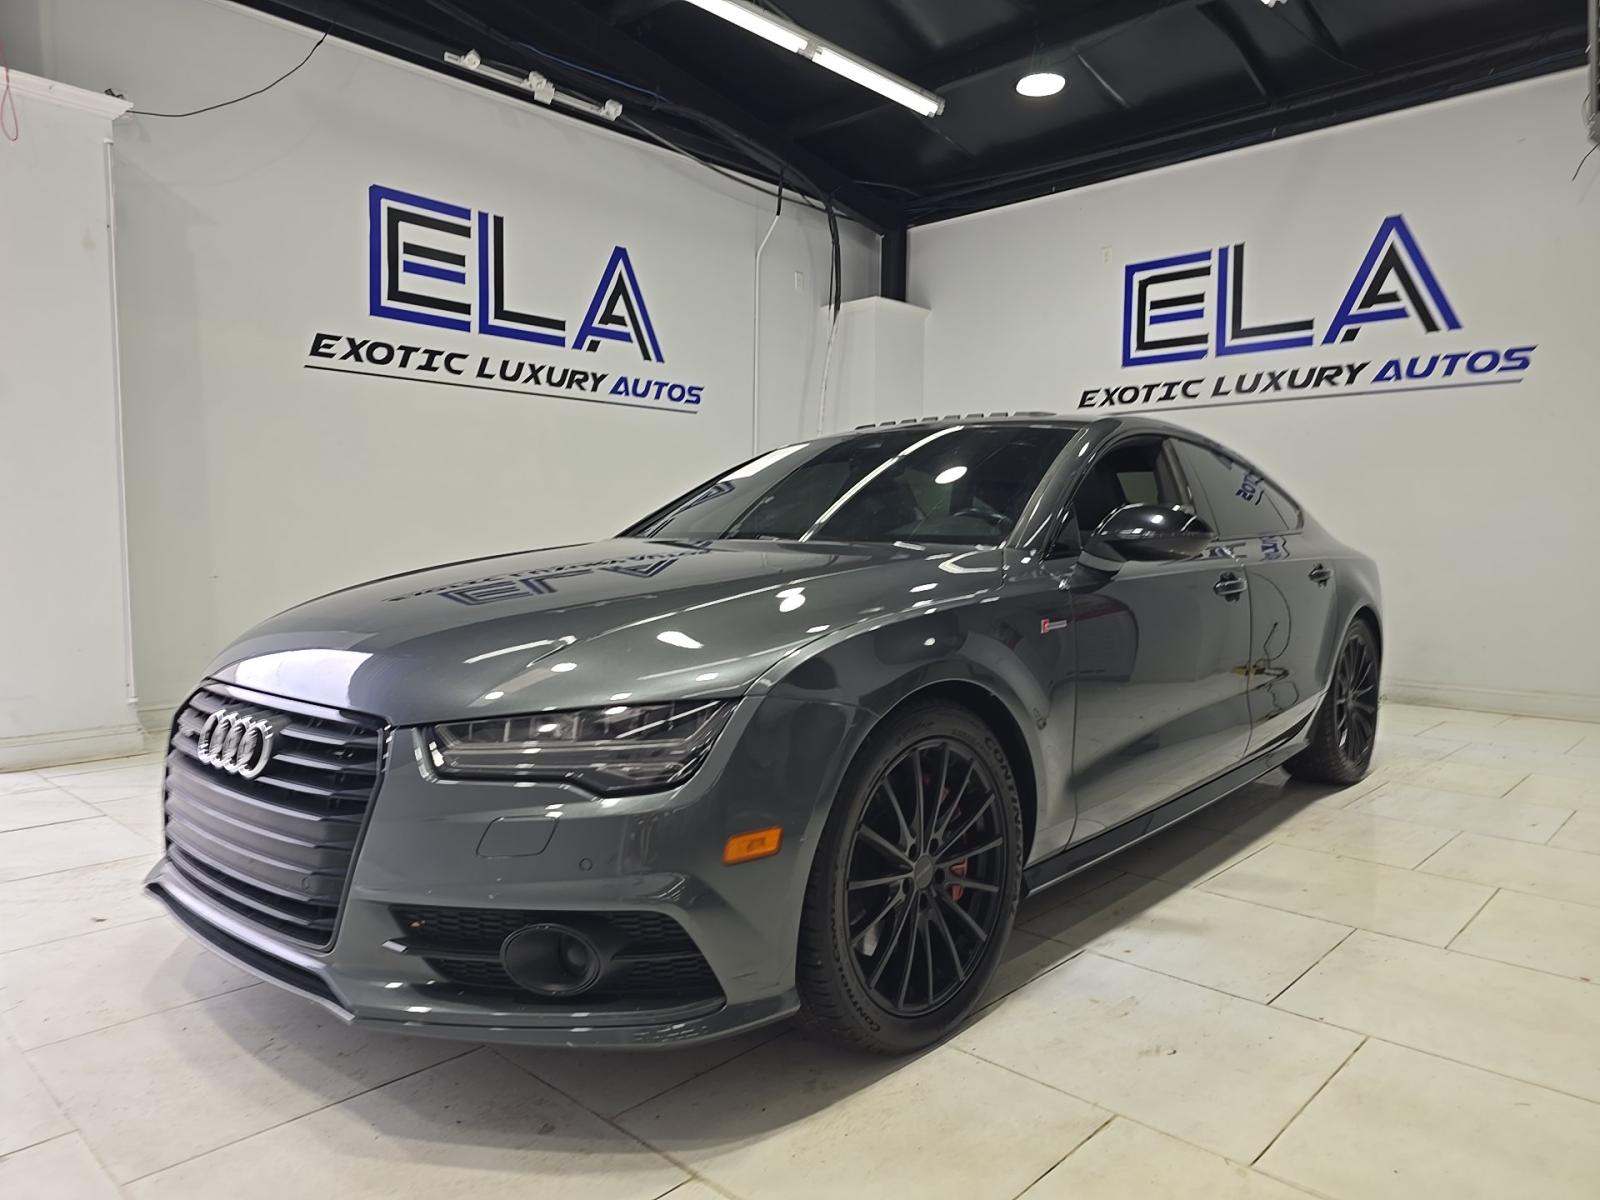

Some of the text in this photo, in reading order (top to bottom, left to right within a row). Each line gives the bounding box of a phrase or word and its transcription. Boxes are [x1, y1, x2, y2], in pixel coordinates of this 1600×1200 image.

[369, 184, 665, 363] ELA
[1122, 214, 1462, 368] ELA
[309, 333, 704, 405] EXOTIC LUXURY AUTOS
[1078, 344, 1538, 409] EXOTIC LUXURY AUTOS
